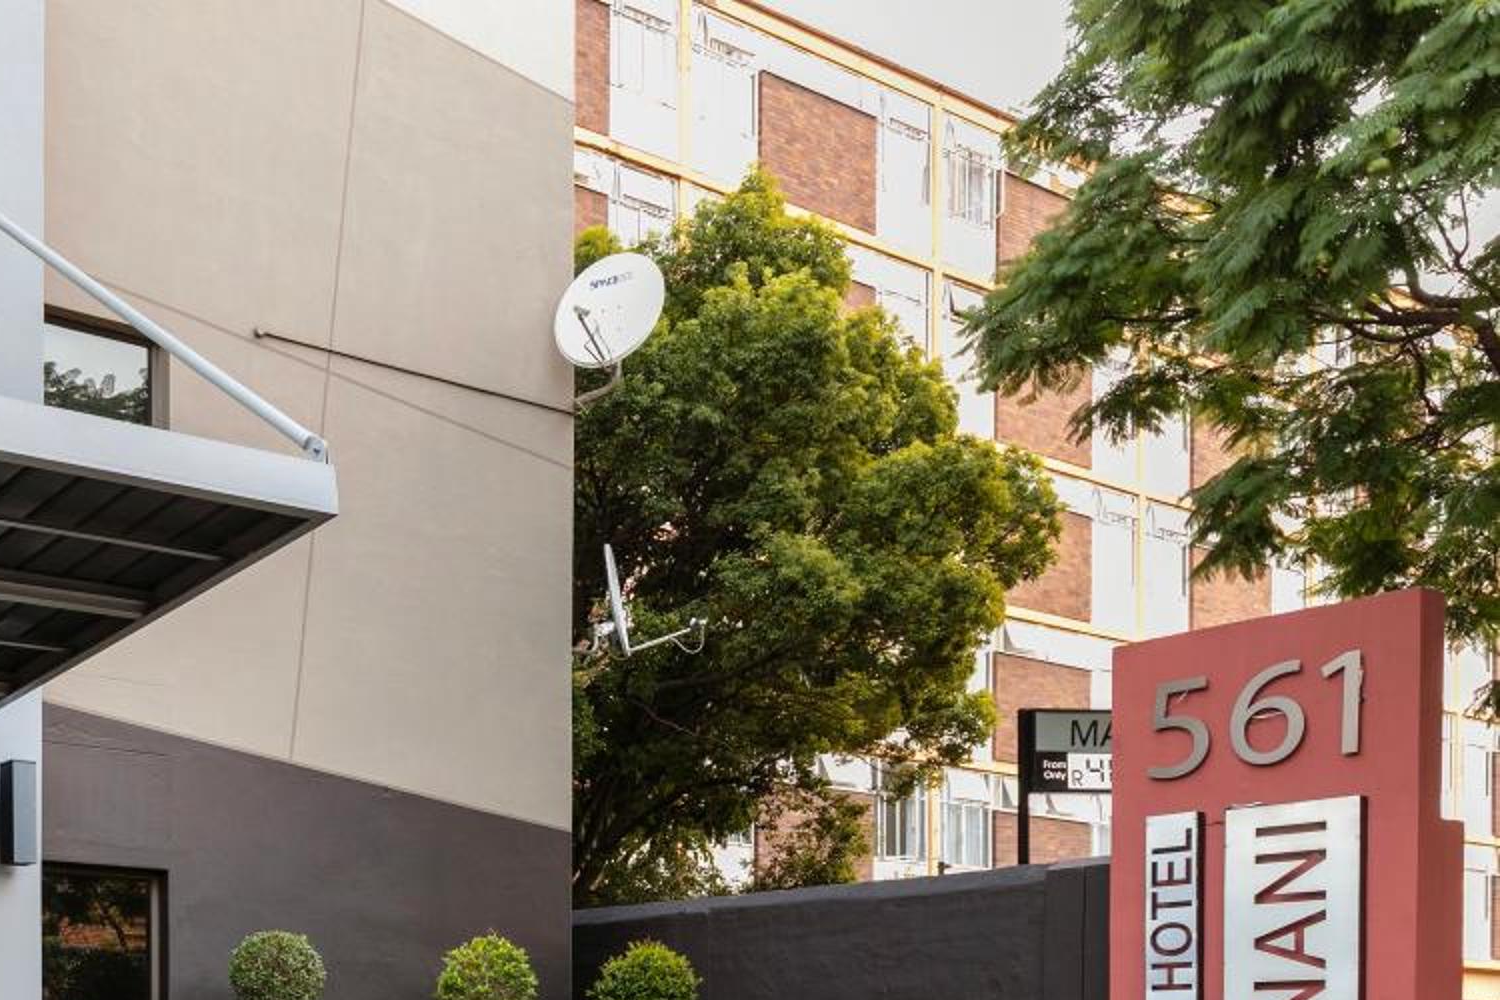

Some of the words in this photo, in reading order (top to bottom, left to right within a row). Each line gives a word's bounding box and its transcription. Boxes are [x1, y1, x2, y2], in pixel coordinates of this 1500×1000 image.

[1146, 648, 1365, 780] 561
[1043, 760, 1067, 769] From
[1043, 770, 1067, 781] Only
[1150, 827, 1193, 992] HOTEL
